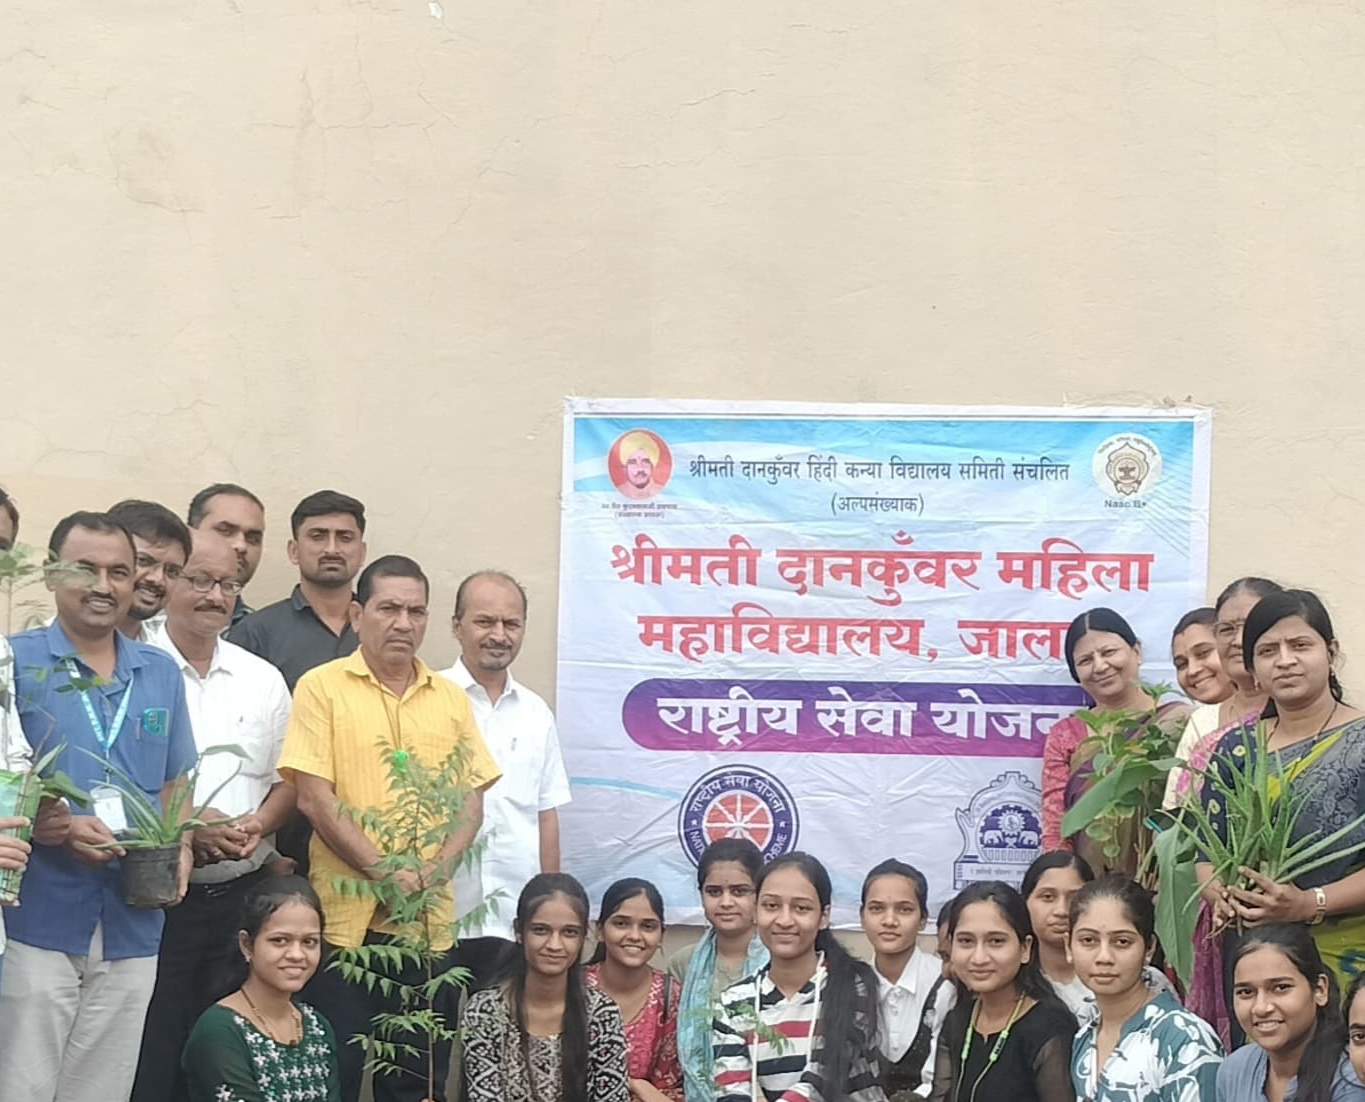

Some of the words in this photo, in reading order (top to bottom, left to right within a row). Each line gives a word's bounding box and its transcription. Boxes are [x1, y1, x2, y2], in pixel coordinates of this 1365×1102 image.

[689, 454, 734, 480] श्रीमती
[740, 455, 800, 485] दानकुँवर
[806, 453, 837, 482] हिंदी
[844, 460, 883, 480] कन्या
[890, 455, 951, 481] विद्यालय
[959, 455, 1006, 482] समिती
[1012, 457, 1070, 482] संचलित
[830, 492, 924, 517] (अल्पसंख्याक)
[611, 533, 762, 586] श्रीमती
[776, 530, 982, 606] दानकुँवर
[996, 537, 1154, 600] महिला
[637, 601, 938, 662] महाविद्यालय,
[957, 620, 1073, 660] जाल
[656, 685, 803, 746] राष्ट्रीय
[815, 686, 917, 737] सेवा
[930, 687, 1080, 740] योजन
